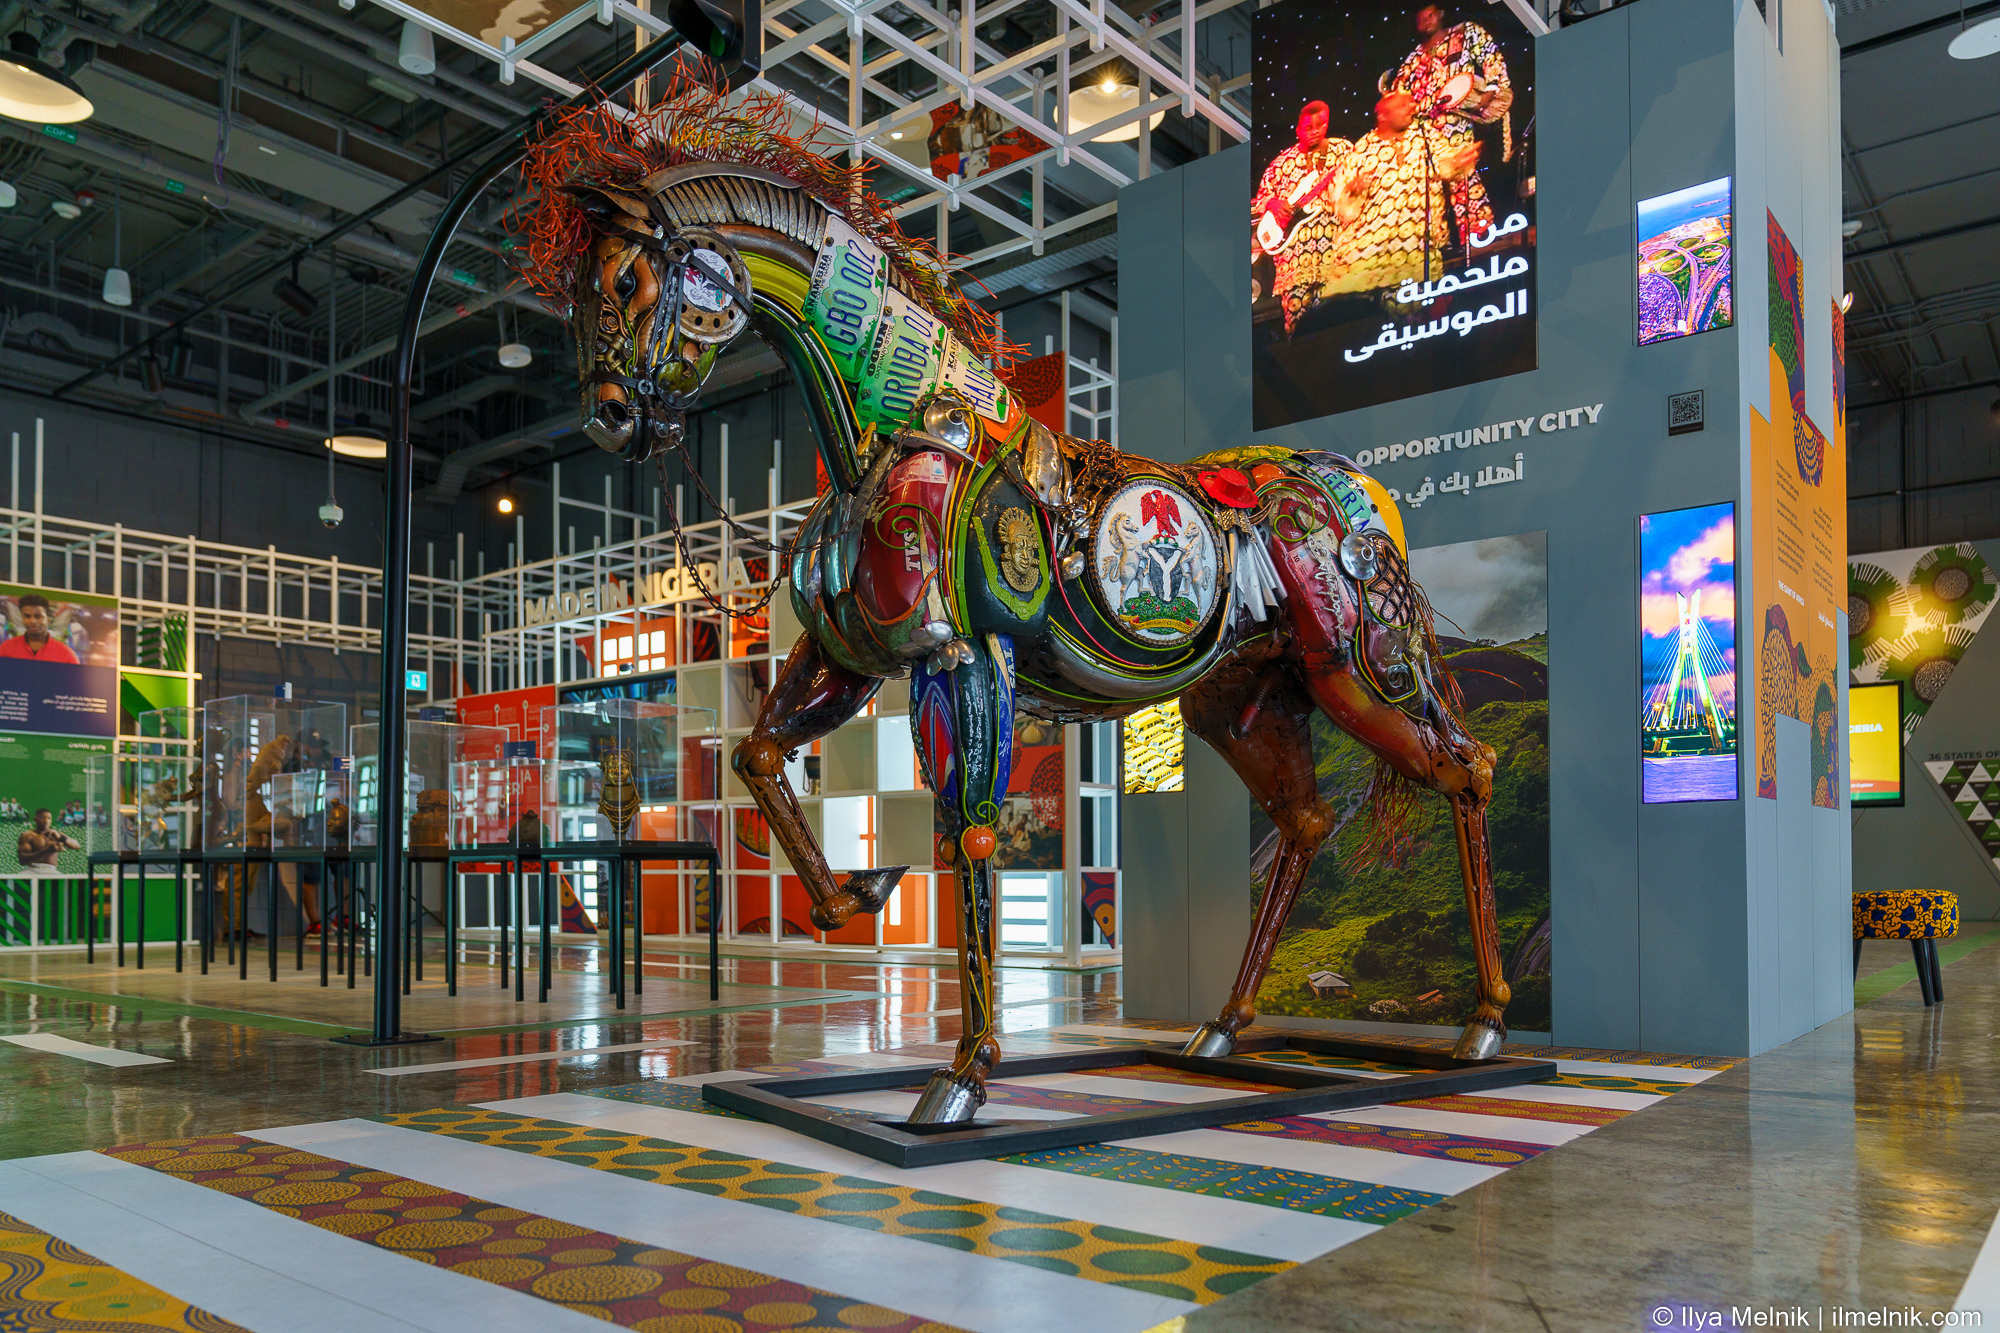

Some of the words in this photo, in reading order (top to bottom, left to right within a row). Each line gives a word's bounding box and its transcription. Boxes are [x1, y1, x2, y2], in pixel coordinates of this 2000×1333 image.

[1469, 213, 1528, 248] من
[806, 253, 829, 315] ANAMBRA
[841, 239, 876, 289] 002
[1396, 255, 1529, 306] ملحمية
[823, 289, 867, 361] IGBO
[902, 305, 934, 338] 01
[1344, 288, 1527, 363] الموسيقى
[867, 321, 889, 377] OGUN
[874, 344, 888, 379] GATEWAY
[883, 324, 894, 344] STATE
[878, 335, 930, 424] YORUBA
[931, 453, 942, 462] 10
[1355, 417, 1535, 467] OPPORTUNITY
[1539, 403, 1603, 432] CITY
[1405, 476, 1435, 509] في
[1439, 471, 1470, 495] بك
[1474, 452, 1524, 488] أهلا
[1303, 461, 1370, 533] IGERIA
[904, 532, 922, 573] TVS
[525, 587, 596, 625] MADE
[601, 579, 629, 611] IN
[634, 556, 750, 604] NIGERIA
[1944, 751, 1982, 760] STATES
[1985, 750, 2000, 759] OF
